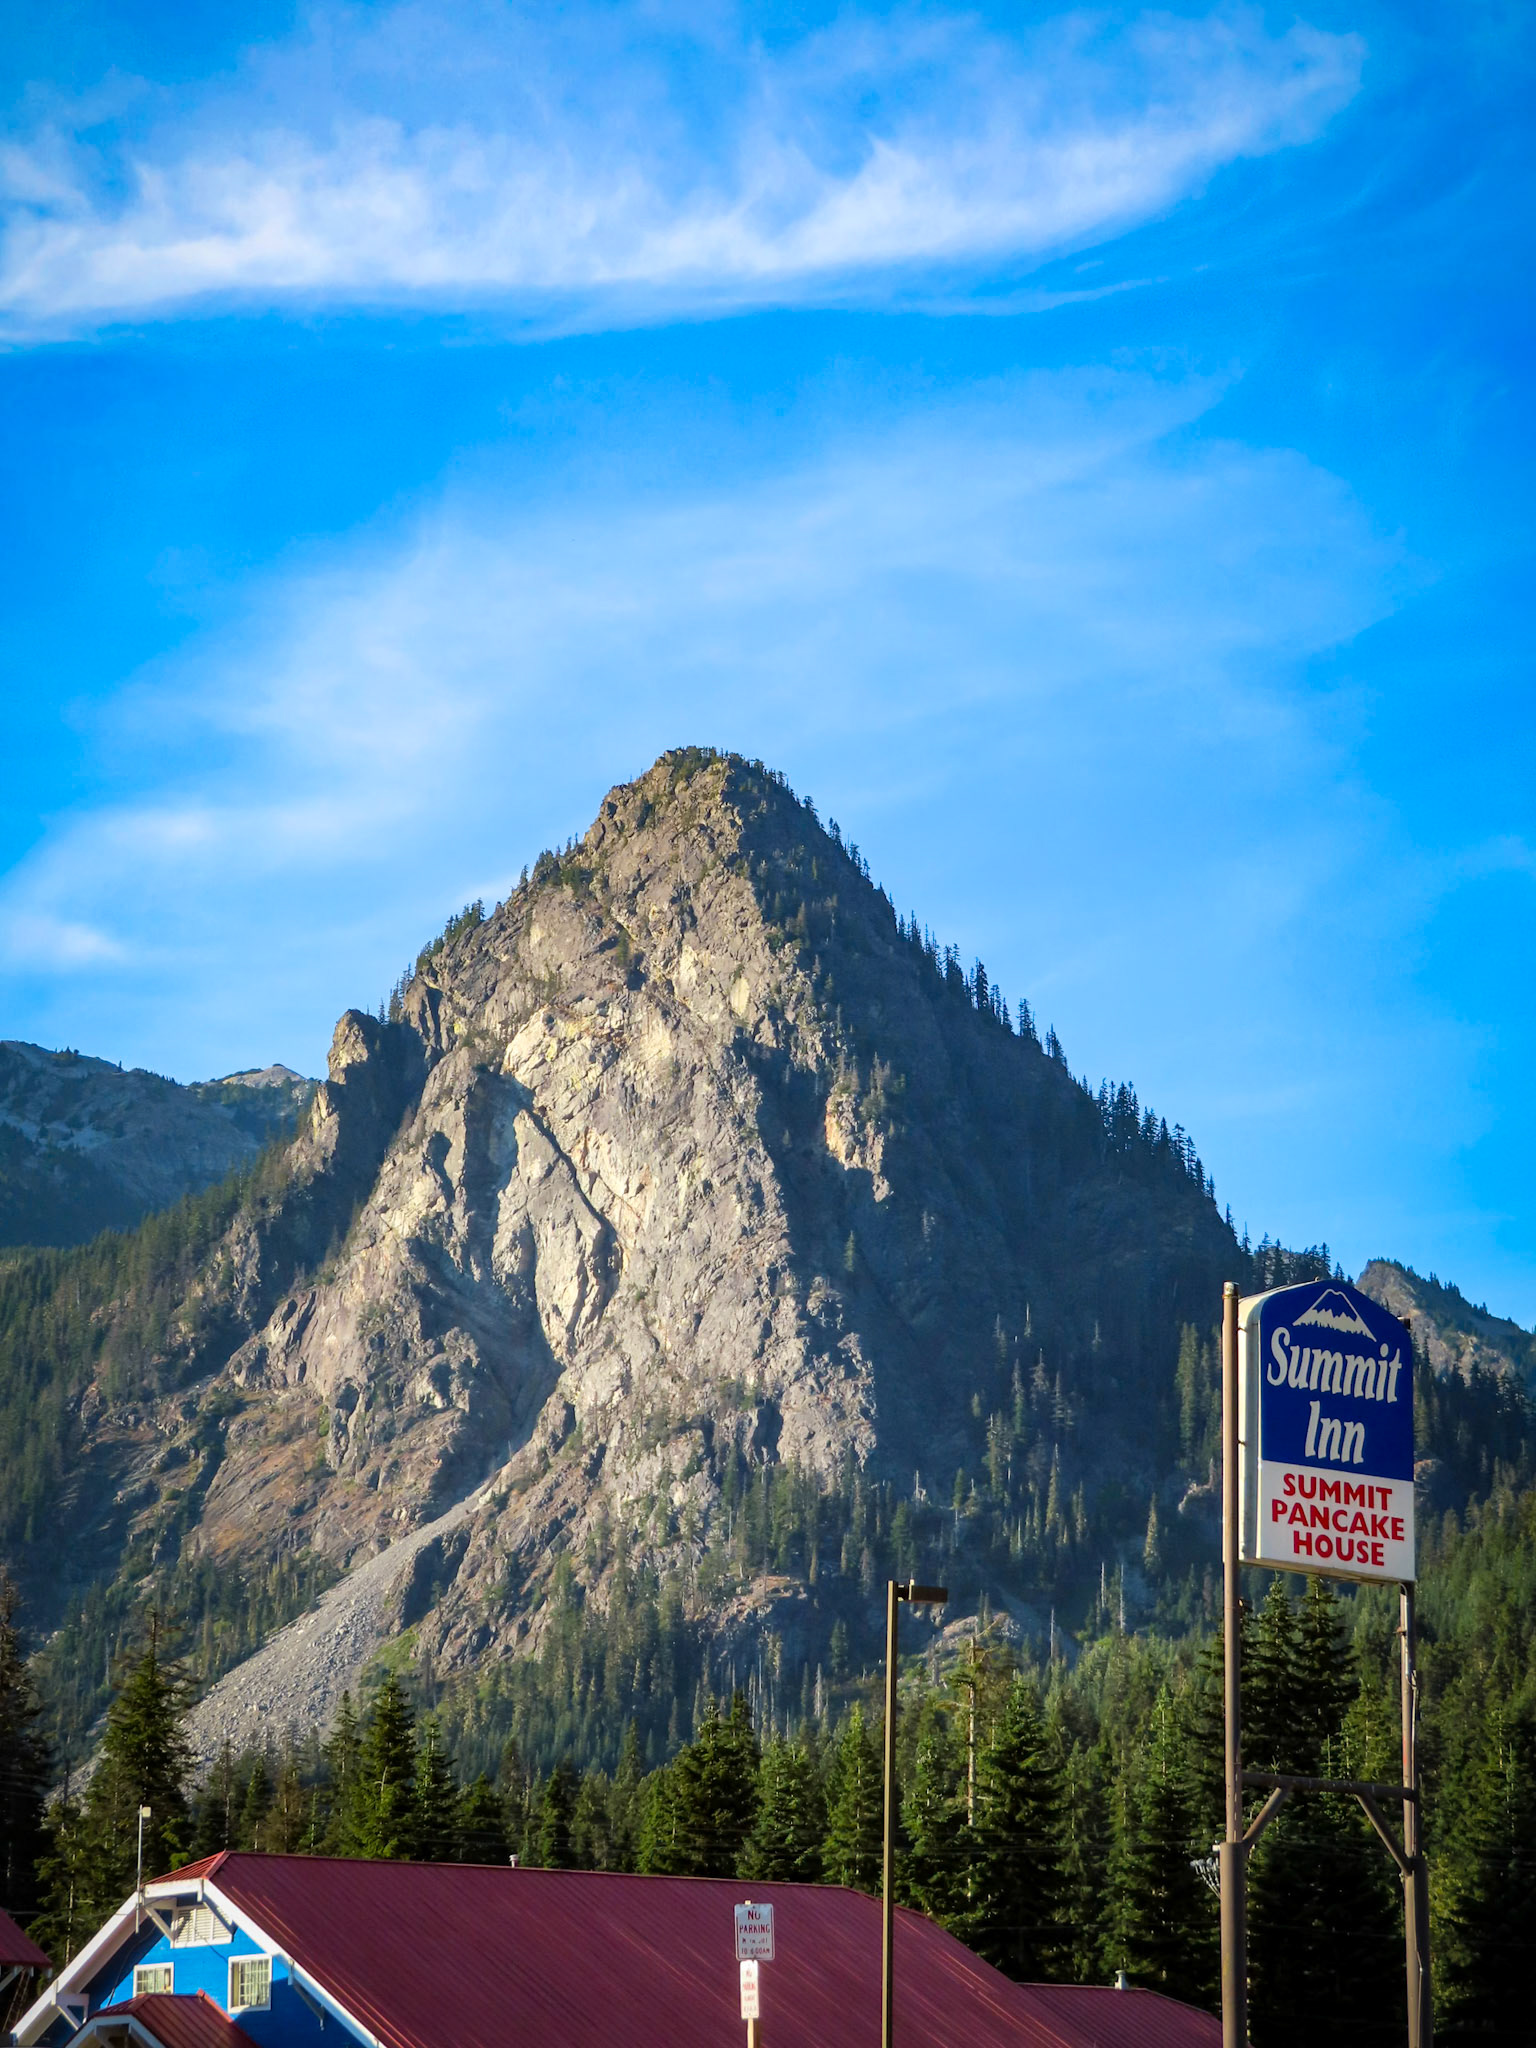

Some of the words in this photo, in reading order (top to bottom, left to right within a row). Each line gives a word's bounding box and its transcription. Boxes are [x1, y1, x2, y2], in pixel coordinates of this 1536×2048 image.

[1267, 1326, 1403, 1403] Summit
[1305, 1400, 1365, 1464] Inn
[1283, 1473, 1392, 1511] SUMMIT
[1271, 1499, 1405, 1541] PANCAKE
[1293, 1530, 1385, 1566] HOUSE
[739, 1924, 771, 1934] PARKING
[747, 1909, 761, 1921] NO
